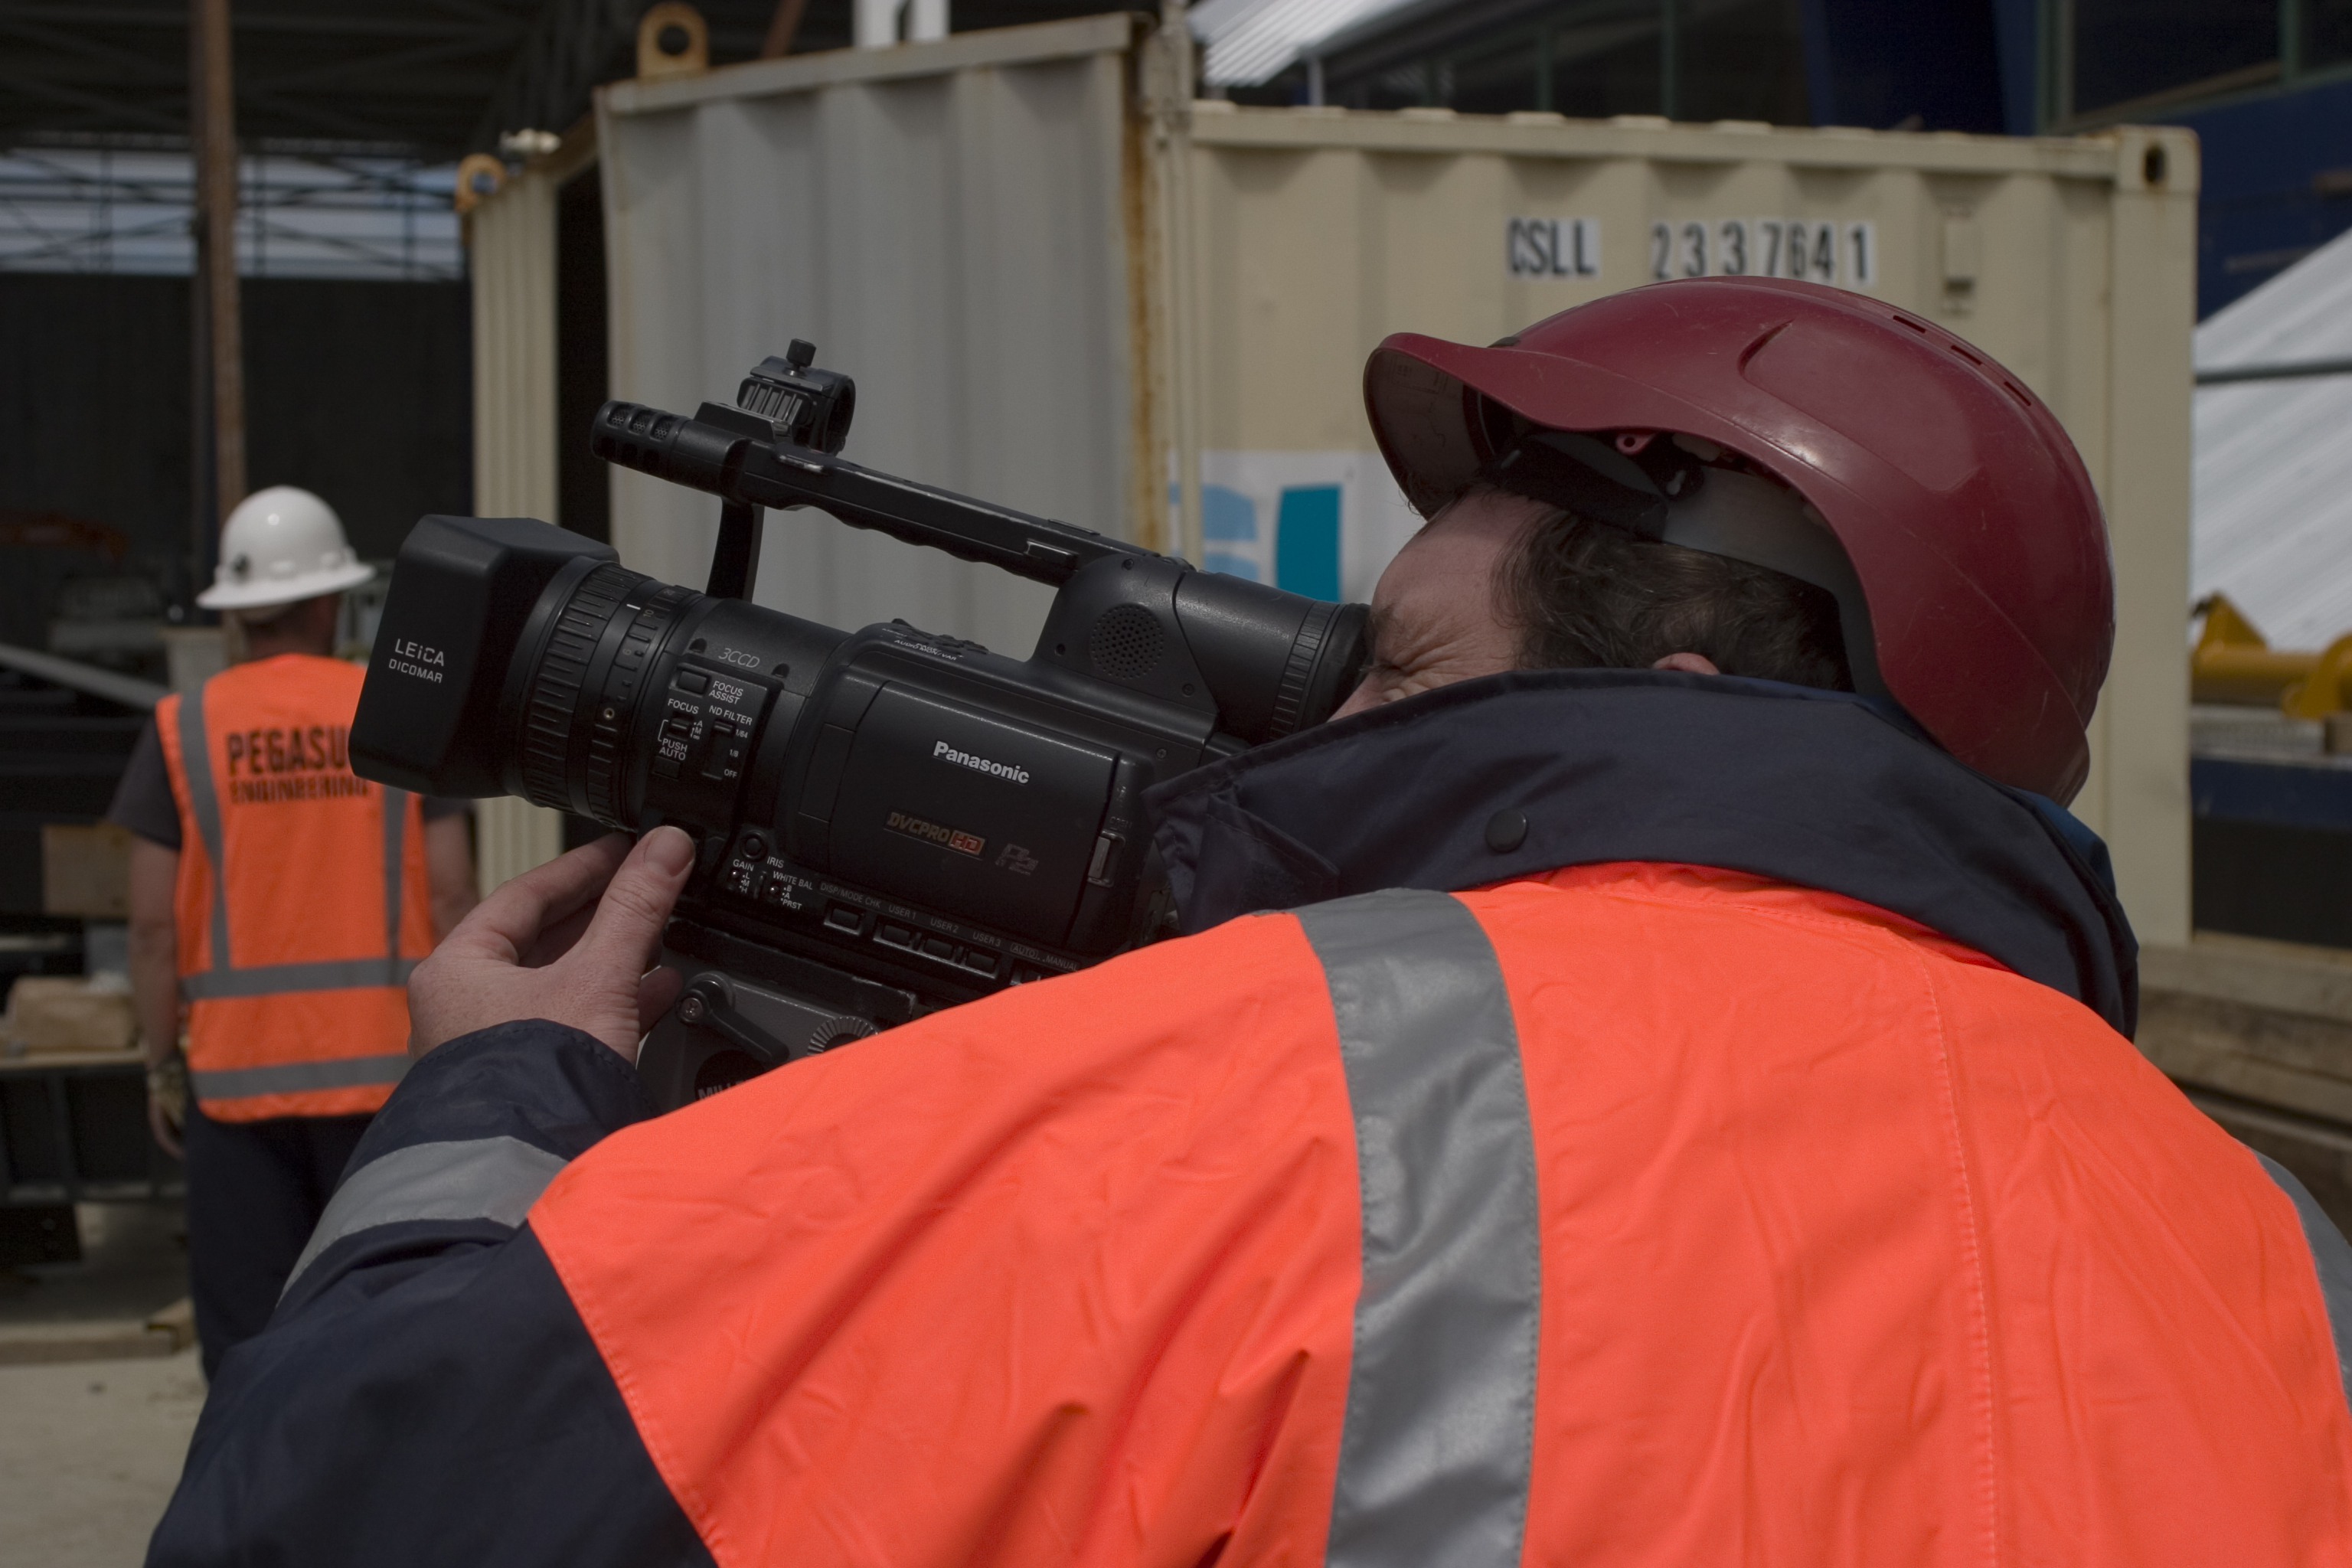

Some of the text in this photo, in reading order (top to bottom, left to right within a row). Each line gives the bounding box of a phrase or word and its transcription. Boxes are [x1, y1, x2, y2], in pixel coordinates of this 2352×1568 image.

[1508, 217, 1597, 276] CSLL
[718, 648, 760, 668] 3CCD
[388, 658, 443, 684] DICOMAR
[713, 681, 743, 697] FOCUS
[708, 690, 740, 705] ASSIST
[667, 698, 700, 714] FOCUS
[709, 705, 753, 726] ND FILTER
[735, 729, 749, 739] 1/64
[227, 727, 349, 775] PEGASU
[658, 746, 686, 761] AUTO
[662, 738, 688, 753] PUSH
[933, 740, 1030, 785] Panasonic
[724, 769, 737, 779] OFF
[887, 812, 985, 855] DVCPRO HD
[733, 859, 754, 871] GAIN
[767, 856, 785, 869] IRIS
[773, 871, 813, 890] WHITE BAL
[820, 882, 881, 909] DISP/MODE CHK
[782, 899, 802, 910] PRST
[888, 904, 910, 918] USER
[930, 918, 959, 933] USER 2
[972, 931, 1001, 947] USER 3
[1011, 944, 1080, 971] AUTO MANUAL
